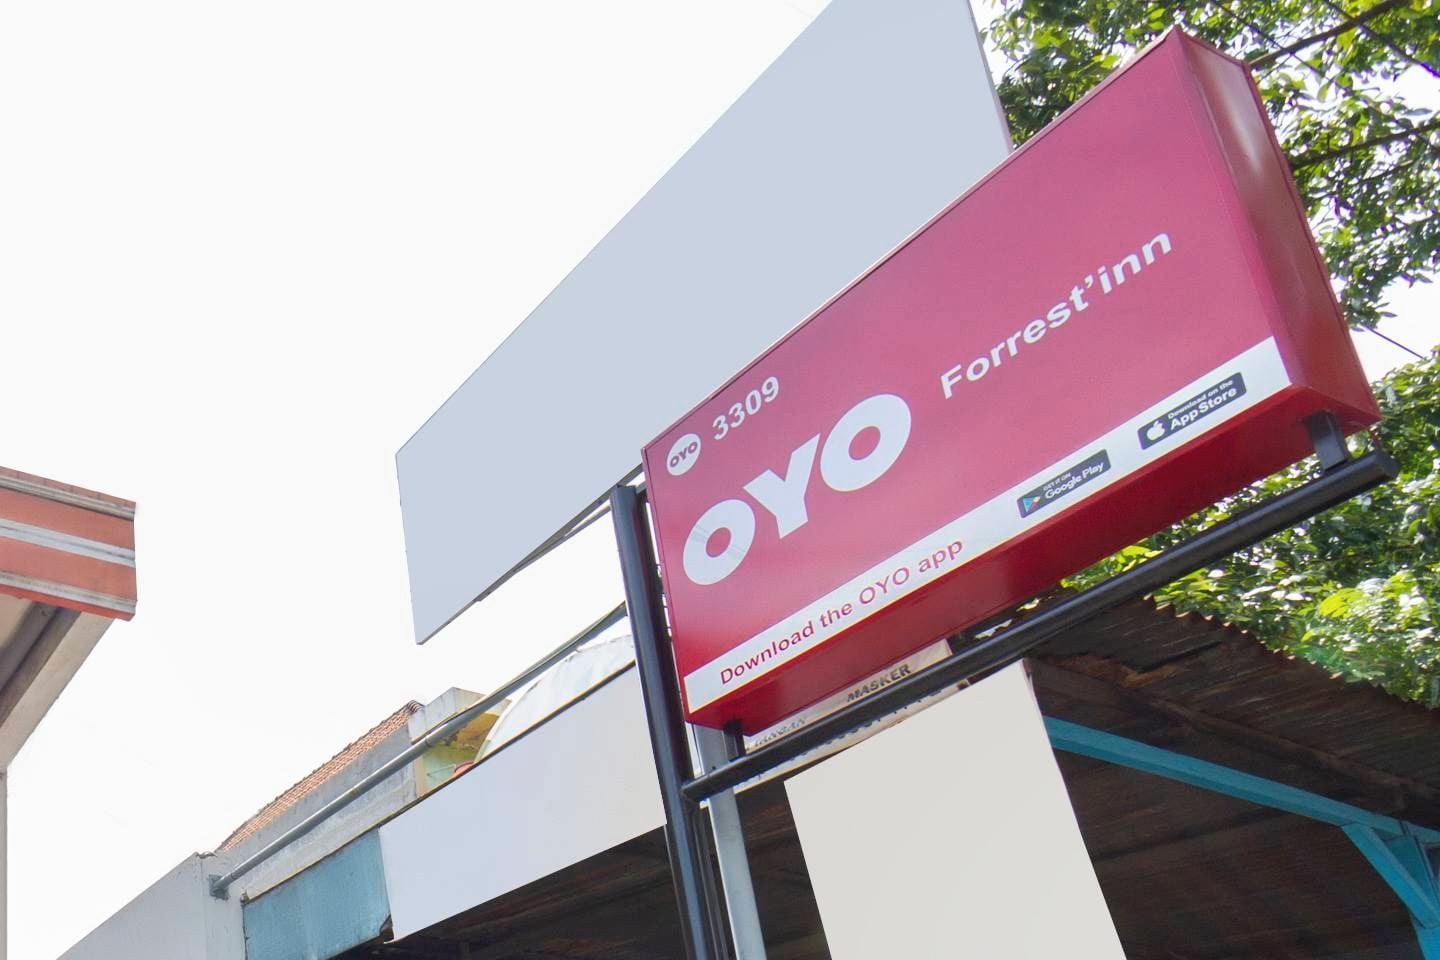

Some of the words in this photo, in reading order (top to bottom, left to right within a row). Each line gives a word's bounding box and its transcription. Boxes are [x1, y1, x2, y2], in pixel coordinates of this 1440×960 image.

[1167, 393, 1208, 419] Download
[1207, 388, 1219, 398] on
[1219, 380, 1234, 391] the
[1170, 409, 1199, 431] App
[1198, 388, 1237, 413] Store
[669, 441, 699, 468] OYO
[712, 376, 780, 441] 3309
[683, 393, 912, 585] OYO
[1045, 475, 1082, 499] Google
[1082, 462, 1104, 479] Play
[720, 621, 815, 685] Download
[819, 602, 853, 628] the
[859, 567, 910, 606] OYO
[918, 540, 963, 573] app
[847, 663, 912, 702] MASKER
